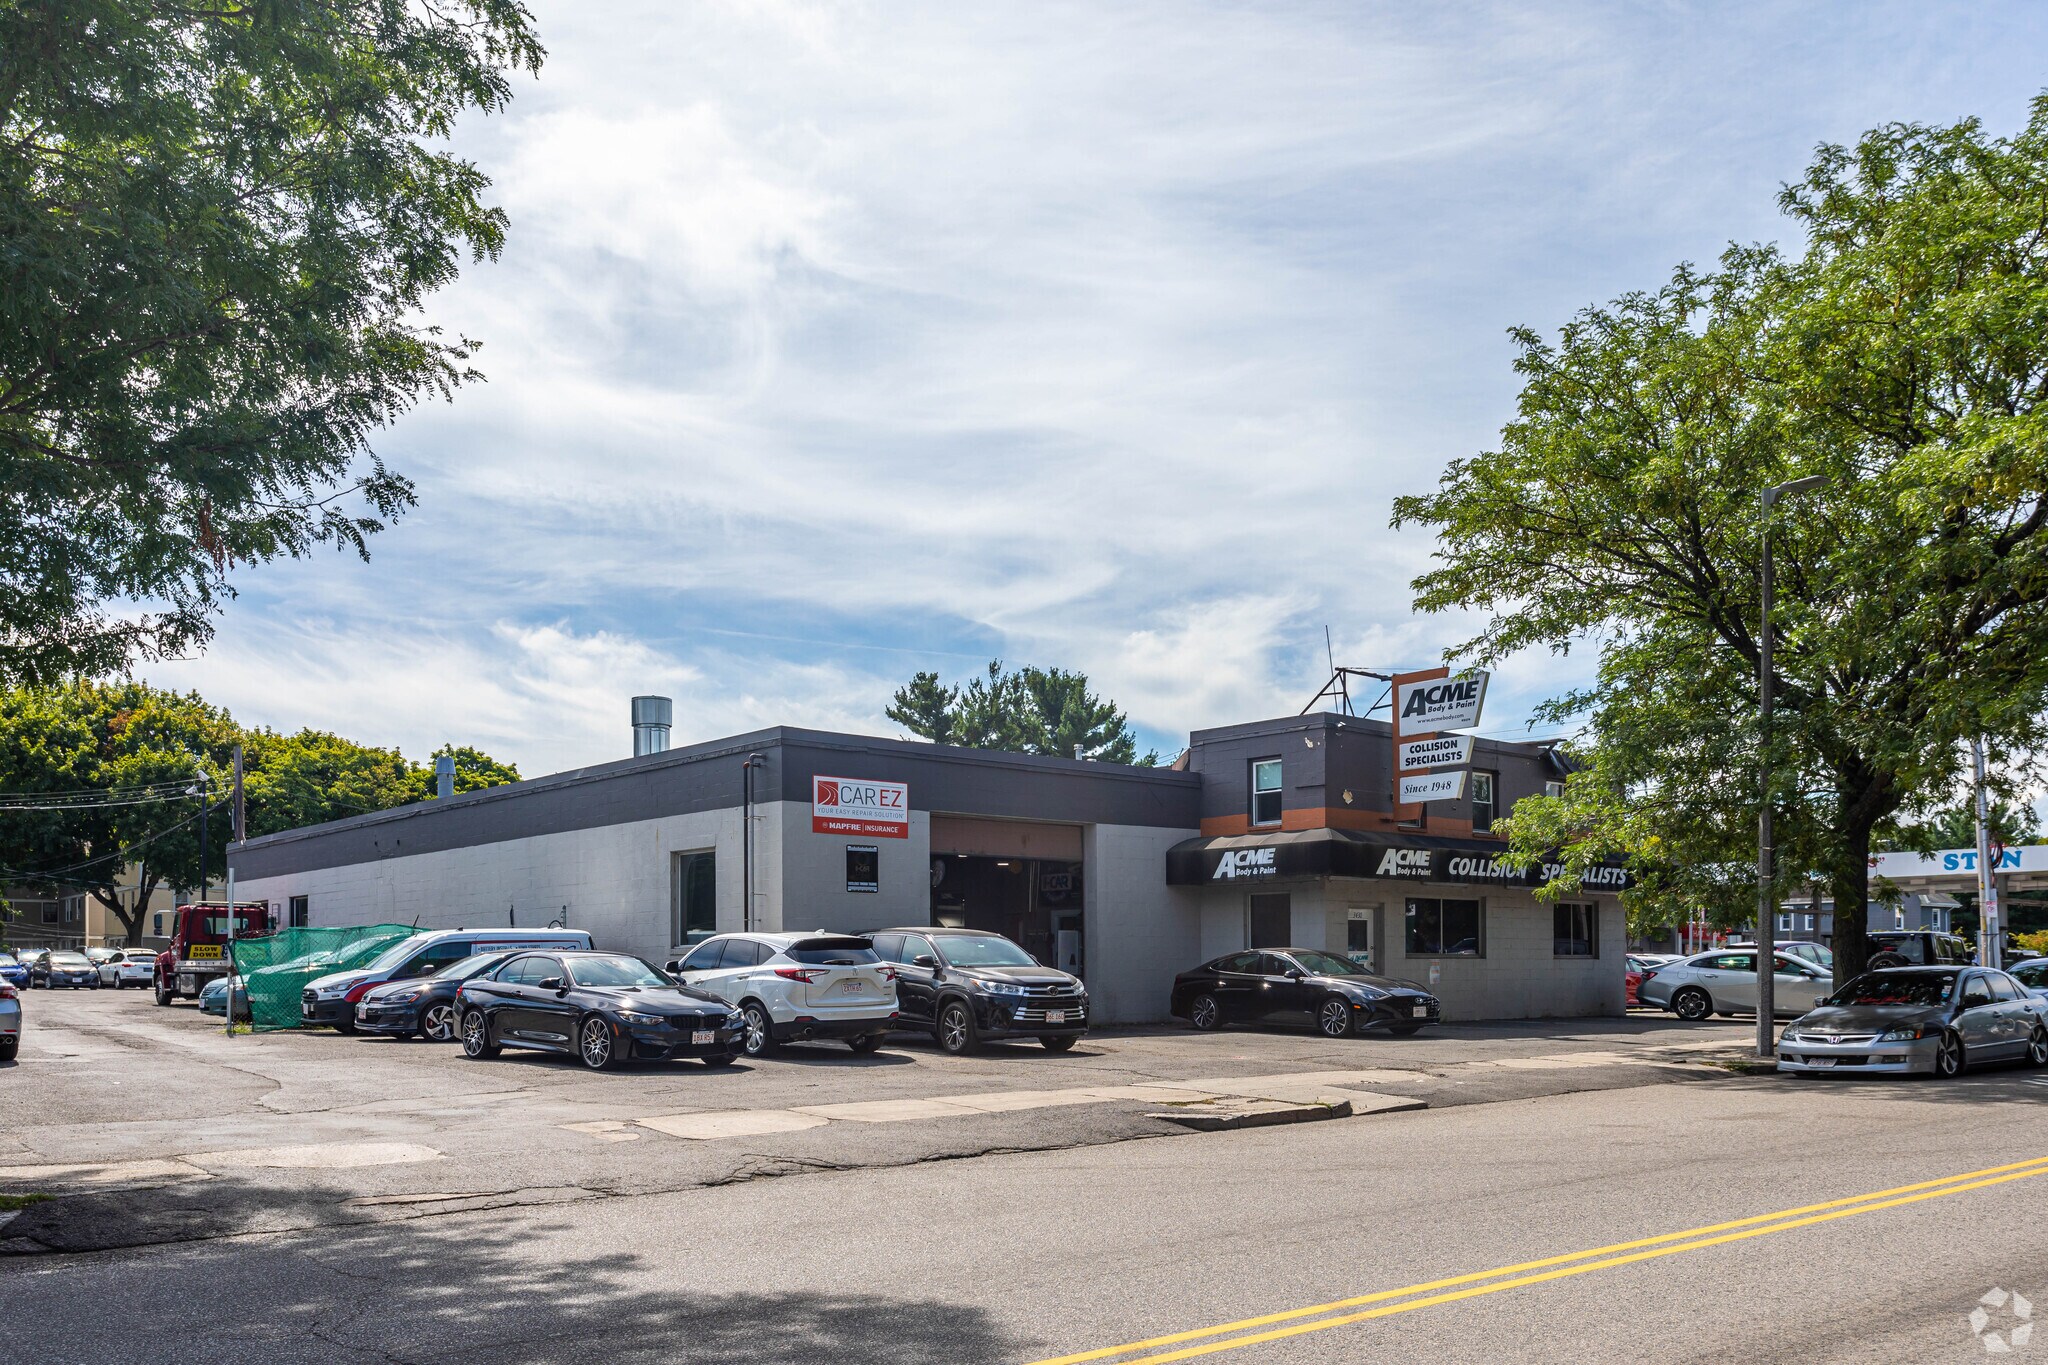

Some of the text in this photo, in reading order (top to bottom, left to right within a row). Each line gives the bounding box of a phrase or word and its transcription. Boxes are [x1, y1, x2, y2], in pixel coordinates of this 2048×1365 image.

[1401, 681, 1480, 718] ACME
[1427, 700, 1476, 713] Body & Paint
[1417, 713, 1465, 724] www.acmebody.com
[1409, 740, 1458, 754] COLLISION
[1405, 751, 1463, 767] SPECIALISTS
[1404, 780, 1452, 795] Since 1948
[840, 785, 902, 808] CAR EZ
[874, 811, 903, 819] SOLUTION
[828, 822, 899, 834] MAPFRE INSURANCE
[1212, 847, 1276, 879] ACME
[1375, 848, 1431, 876] ACME
[1944, 850, 2022, 871] STN
[1236, 866, 1277, 876] Body & Paint
[1397, 867, 1411, 876] Body
[1417, 868, 1432, 876] Paint
[1540, 863, 1628, 885] SPEALISTS
